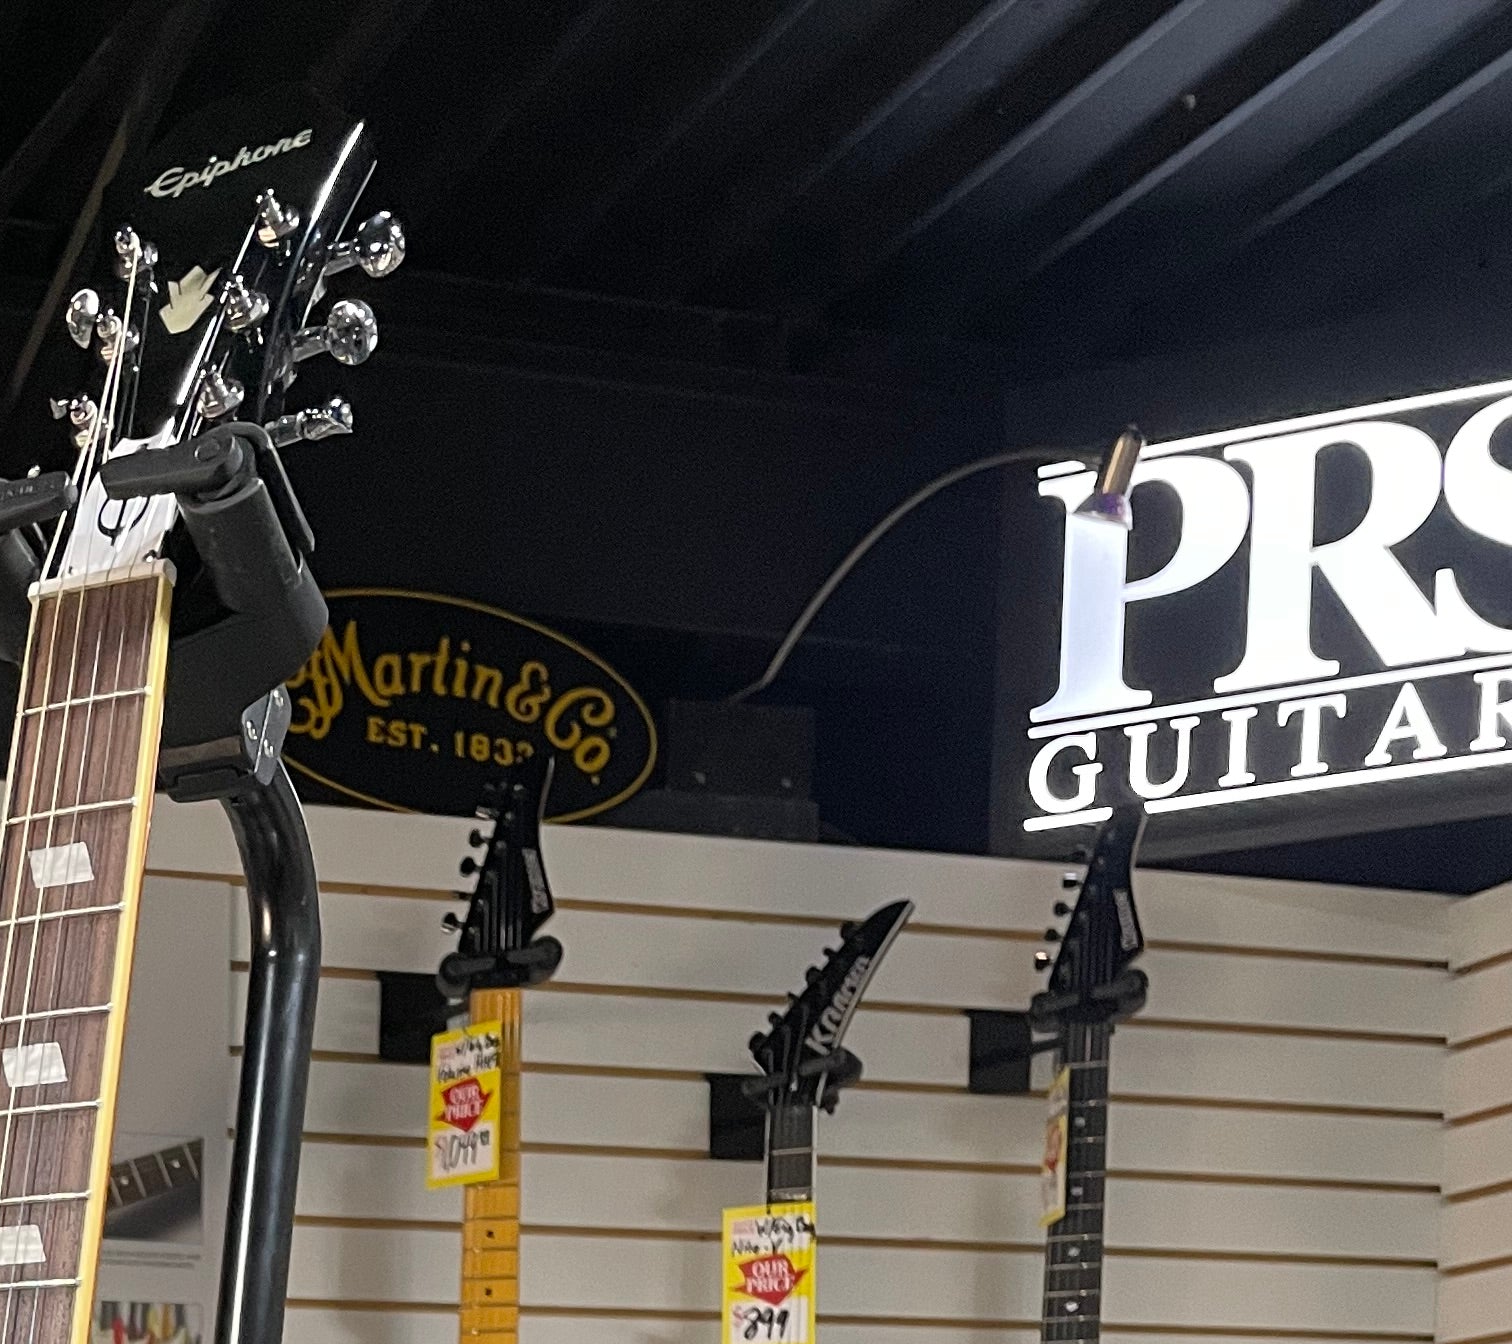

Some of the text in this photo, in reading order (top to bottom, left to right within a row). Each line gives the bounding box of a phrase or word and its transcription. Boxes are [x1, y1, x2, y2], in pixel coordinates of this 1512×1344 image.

[144, 129, 313, 198] Epiphone
[366, 716, 440, 754] EST.
[752, 1260, 789, 1278] OUR
[746, 1275, 796, 1294] PRICE
